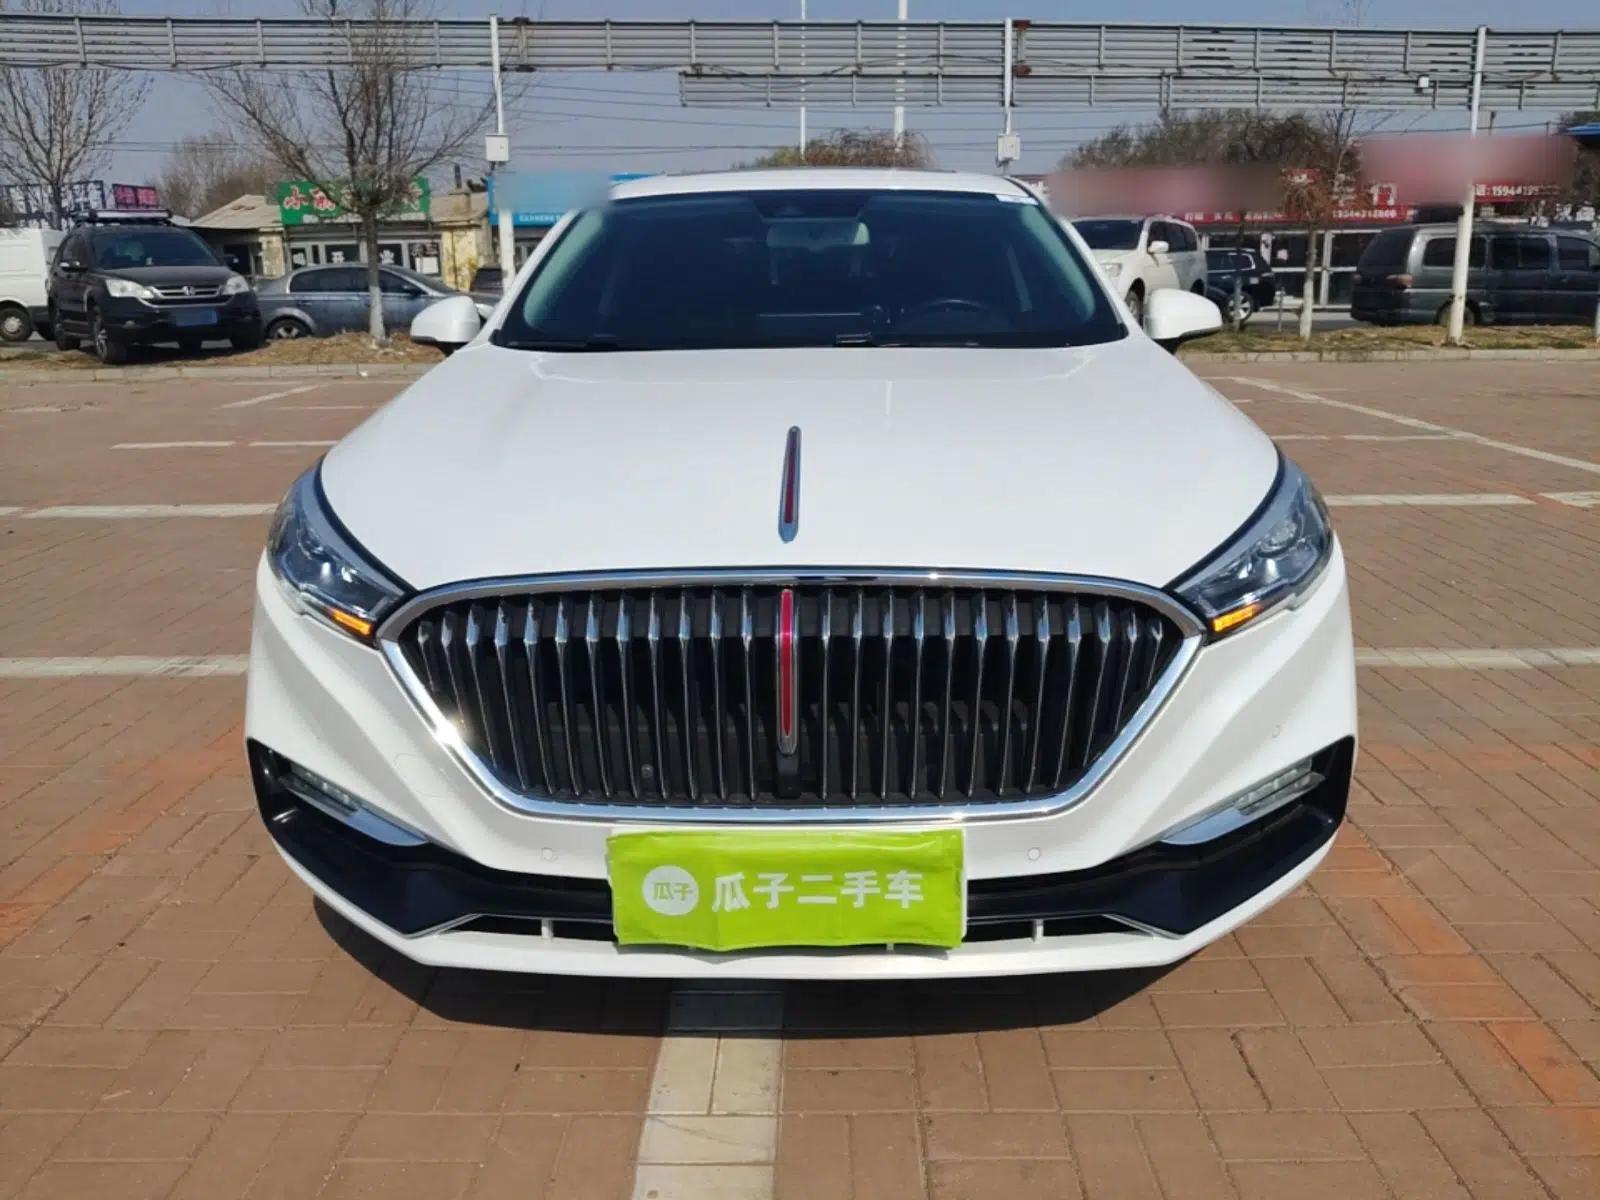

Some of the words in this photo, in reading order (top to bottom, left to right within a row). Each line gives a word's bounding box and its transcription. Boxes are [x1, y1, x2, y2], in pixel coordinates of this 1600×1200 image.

[653, 881, 693, 901] 瓜子
[711, 869, 924, 912] 瓜子二手车
